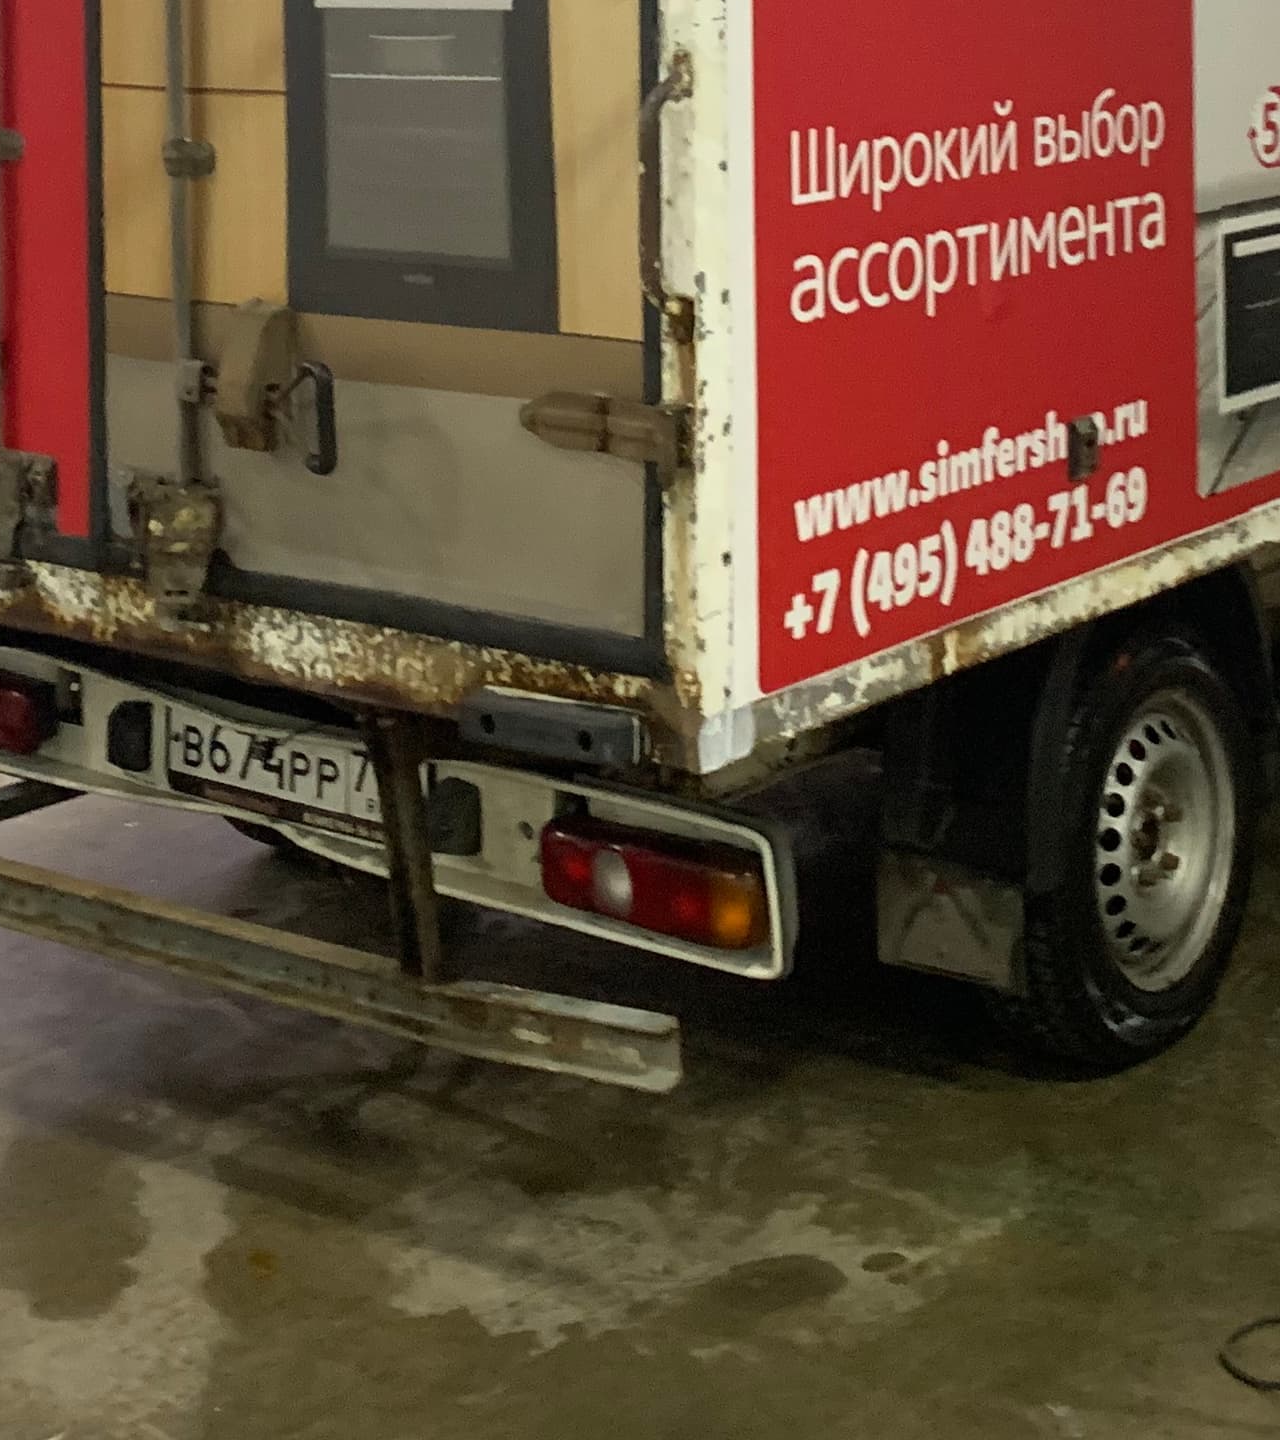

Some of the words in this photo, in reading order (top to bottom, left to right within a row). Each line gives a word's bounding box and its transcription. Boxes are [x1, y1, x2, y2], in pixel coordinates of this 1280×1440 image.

[790, 99, 1018, 213] Широкий
[1033, 87, 1166, 168] выбор
[790, 191, 1166, 323] ассортимента
[793, 399, 1148, 542] www.simfersh.ru
[783, 568, 841, 640] +7
[850, 519, 958, 638] (495)
[965, 466, 1148, 575] 488-71-69
